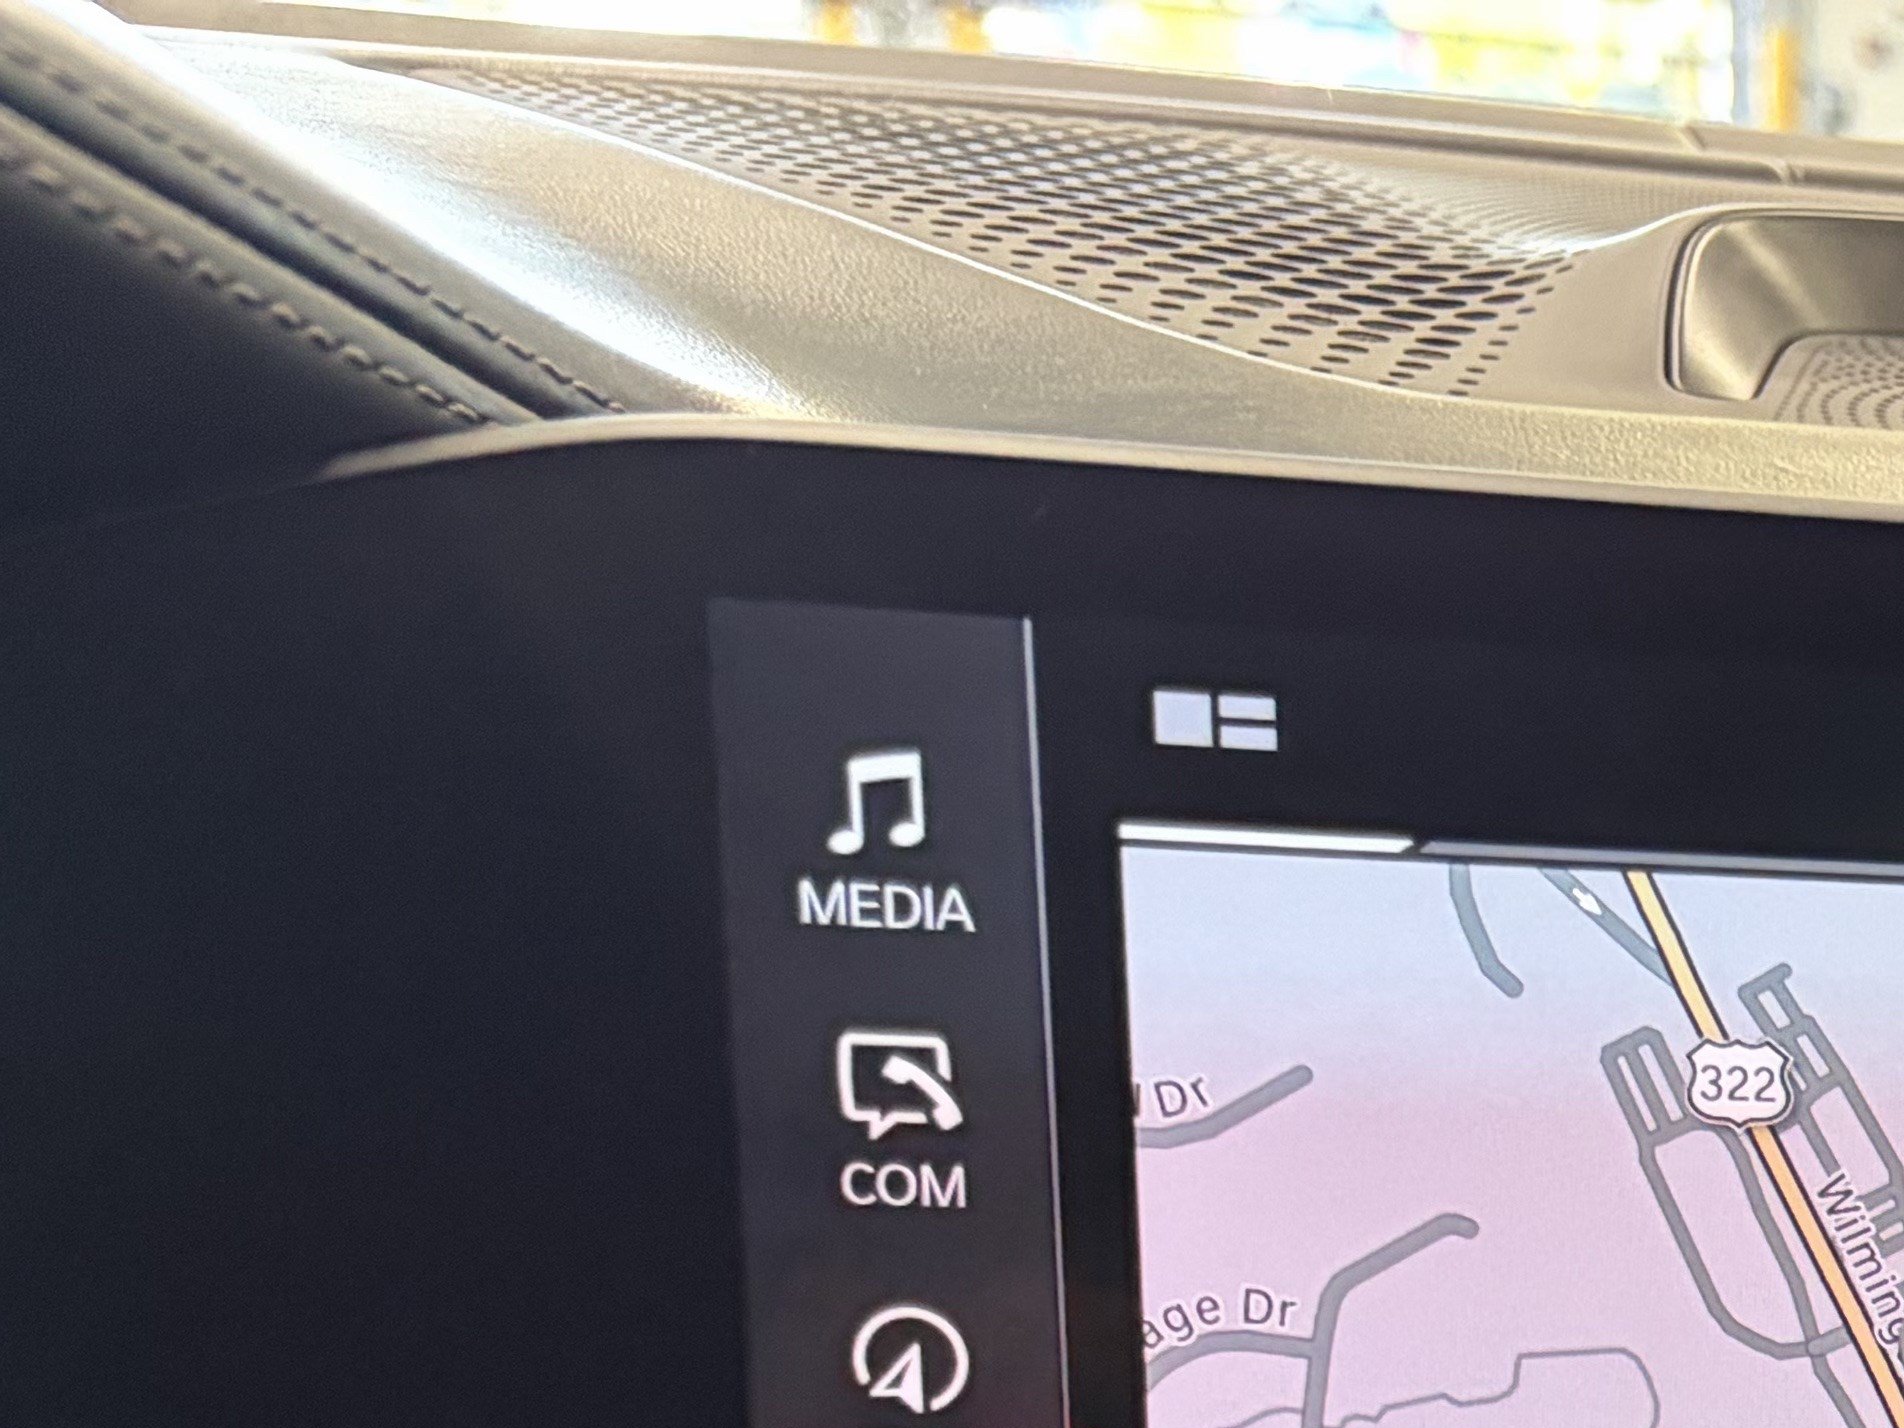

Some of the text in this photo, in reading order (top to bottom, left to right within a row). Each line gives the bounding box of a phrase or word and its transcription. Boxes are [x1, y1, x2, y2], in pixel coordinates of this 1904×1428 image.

[798, 879, 976, 932] MEDIA
[1154, 1076, 1209, 1118] Dr
[1700, 1064, 1776, 1103] 322
[841, 1161, 966, 1208] COM
[1244, 1288, 1297, 1327] Dr
